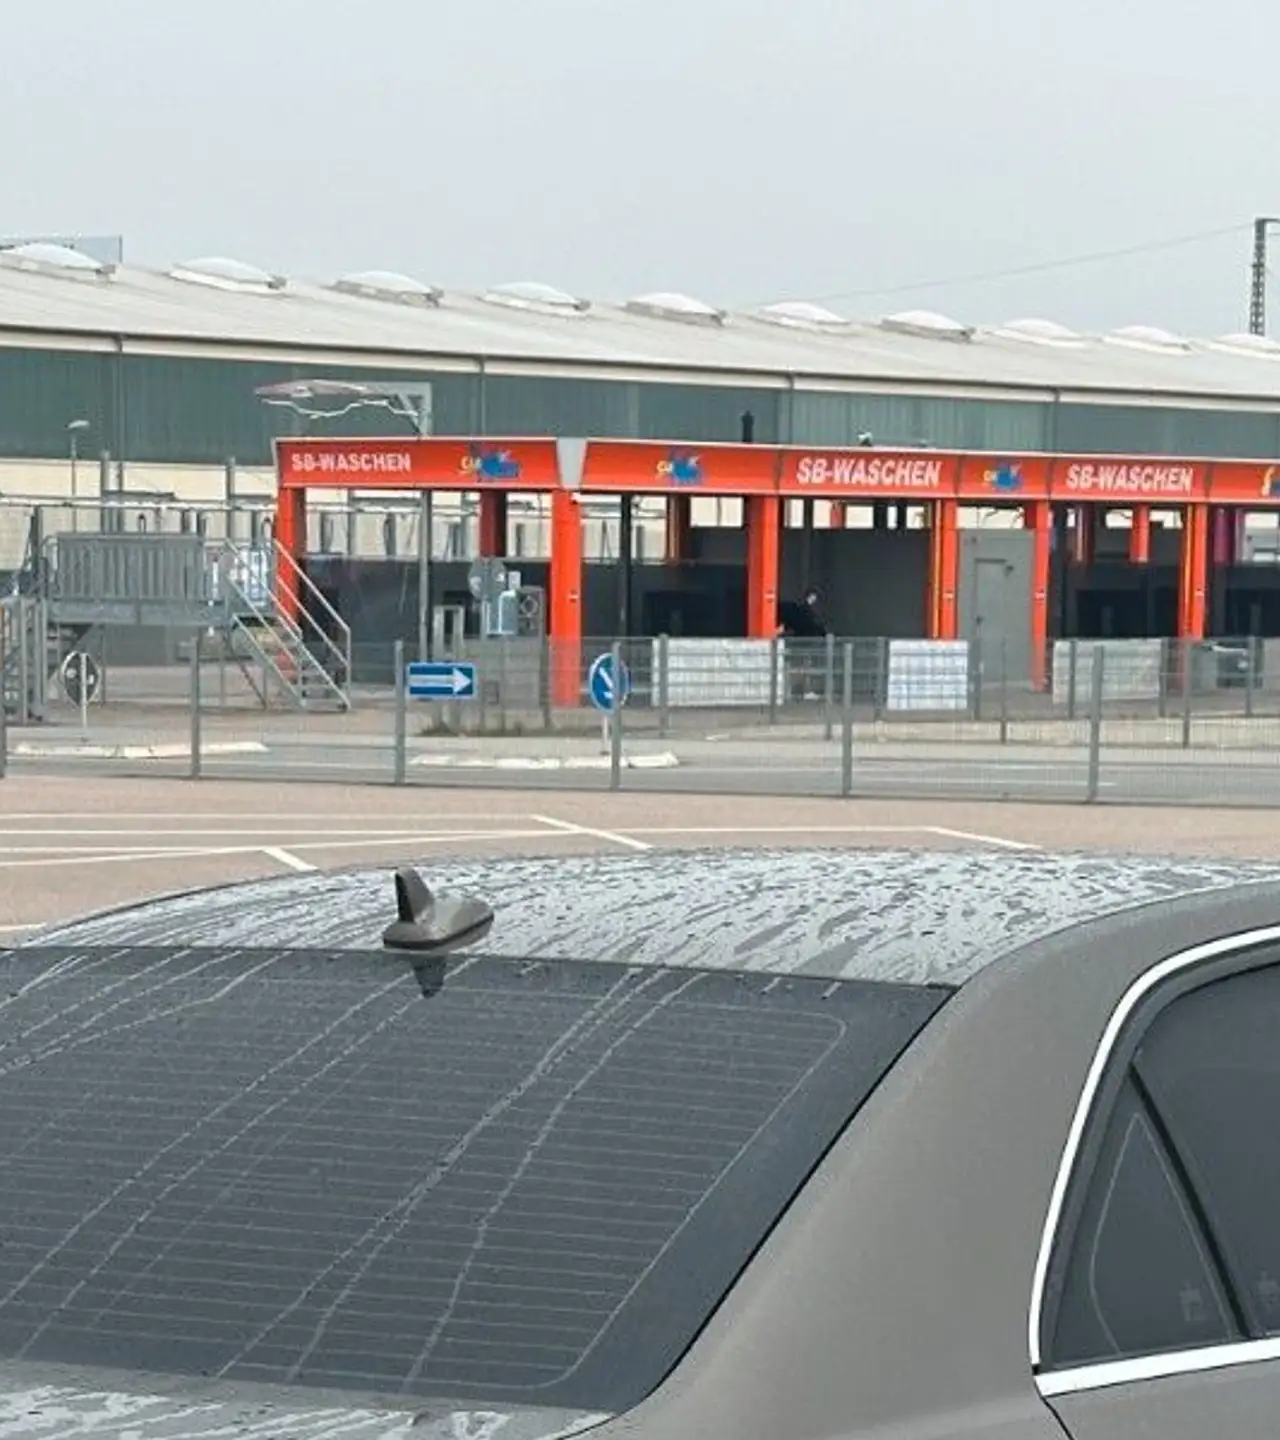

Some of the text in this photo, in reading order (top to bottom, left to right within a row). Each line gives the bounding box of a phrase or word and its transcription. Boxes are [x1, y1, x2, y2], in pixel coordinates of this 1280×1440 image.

[291, 453, 410, 472] SB-WASCHEN
[796, 457, 940, 487] SB-WASCHEN
[1065, 464, 1194, 492] SB-WASCHEN
